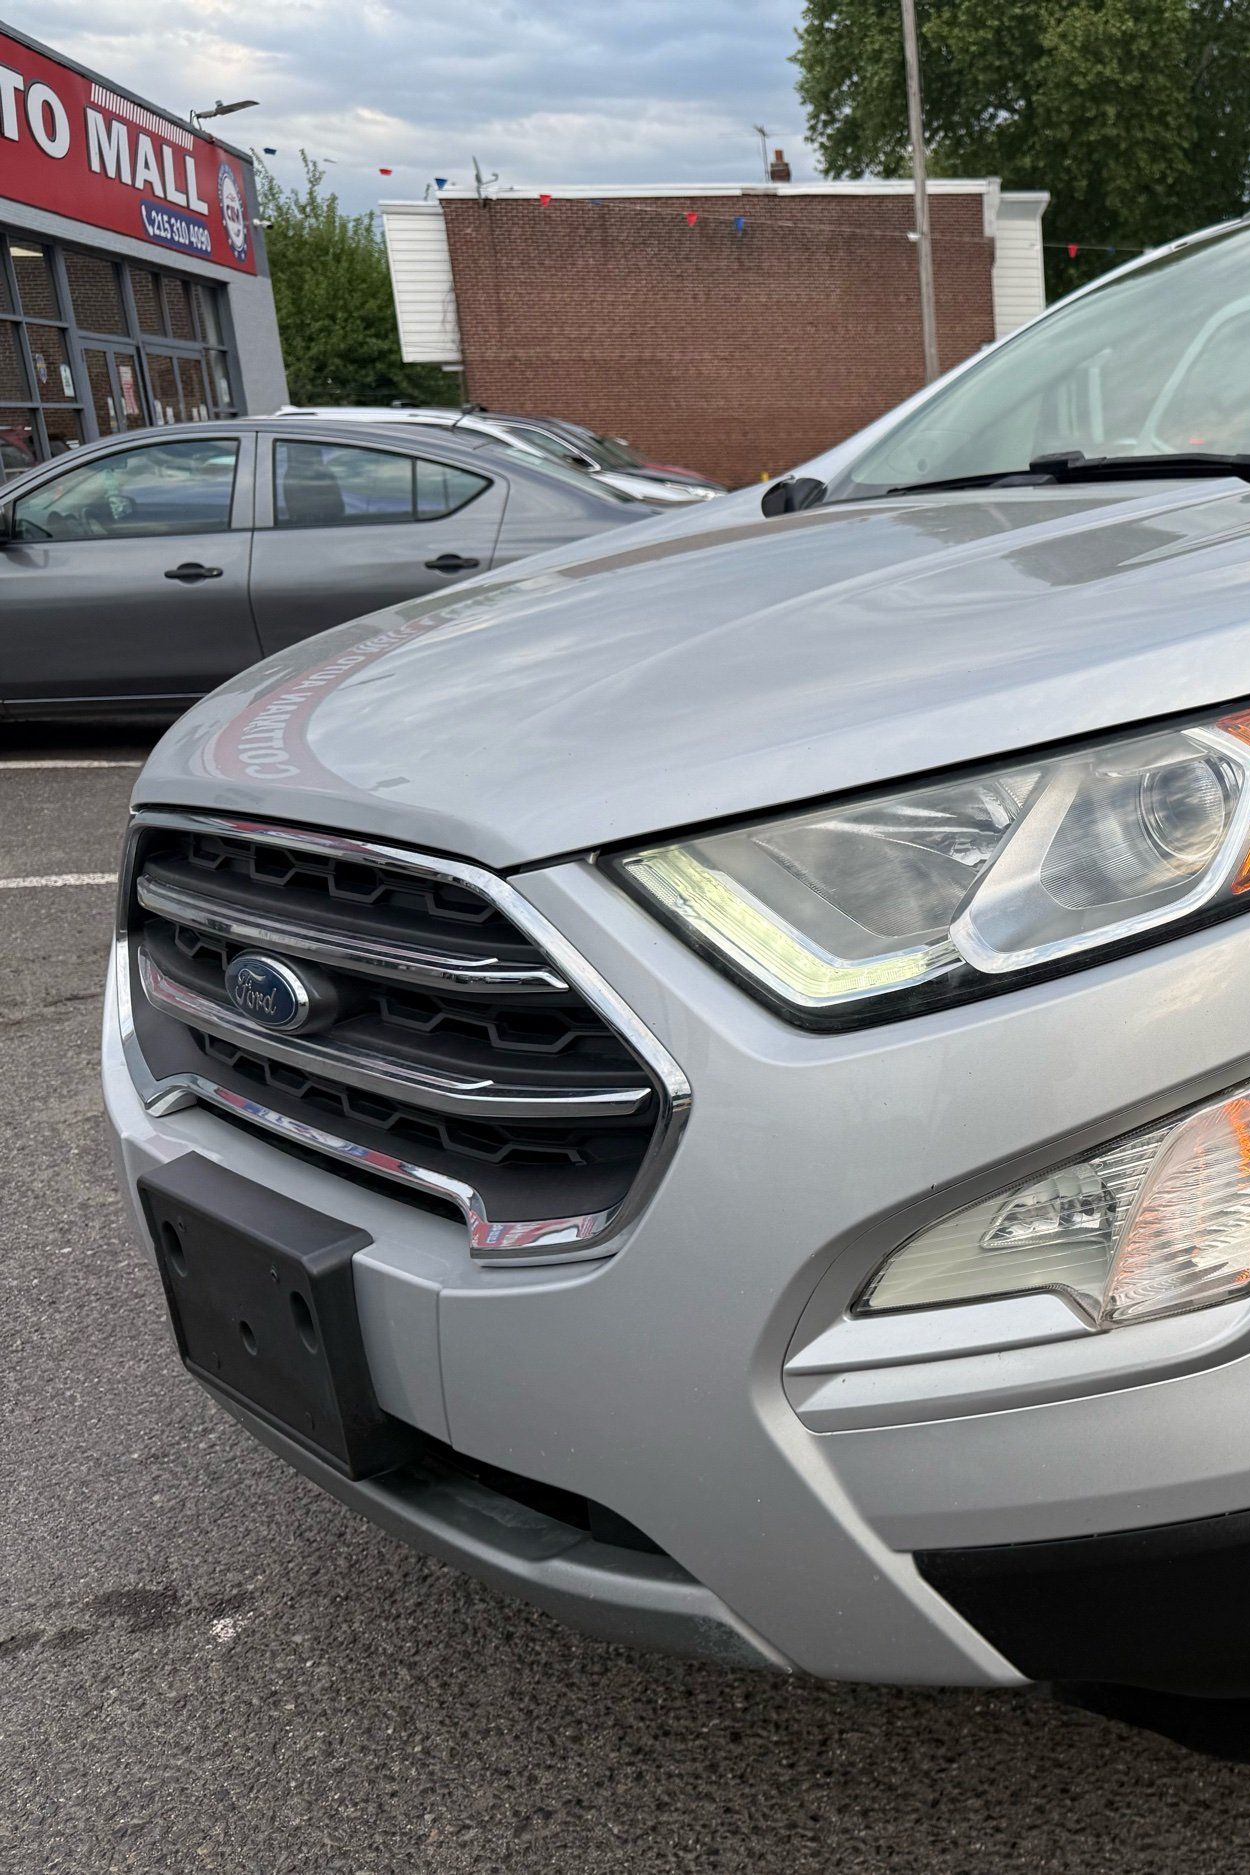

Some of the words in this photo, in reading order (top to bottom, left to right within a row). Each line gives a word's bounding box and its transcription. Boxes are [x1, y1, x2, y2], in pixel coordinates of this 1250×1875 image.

[86, 106, 209, 216] MALL
[152, 210, 171, 239] 215
[171, 217, 189, 245] 310
[235, 968, 277, 1016] Ford
